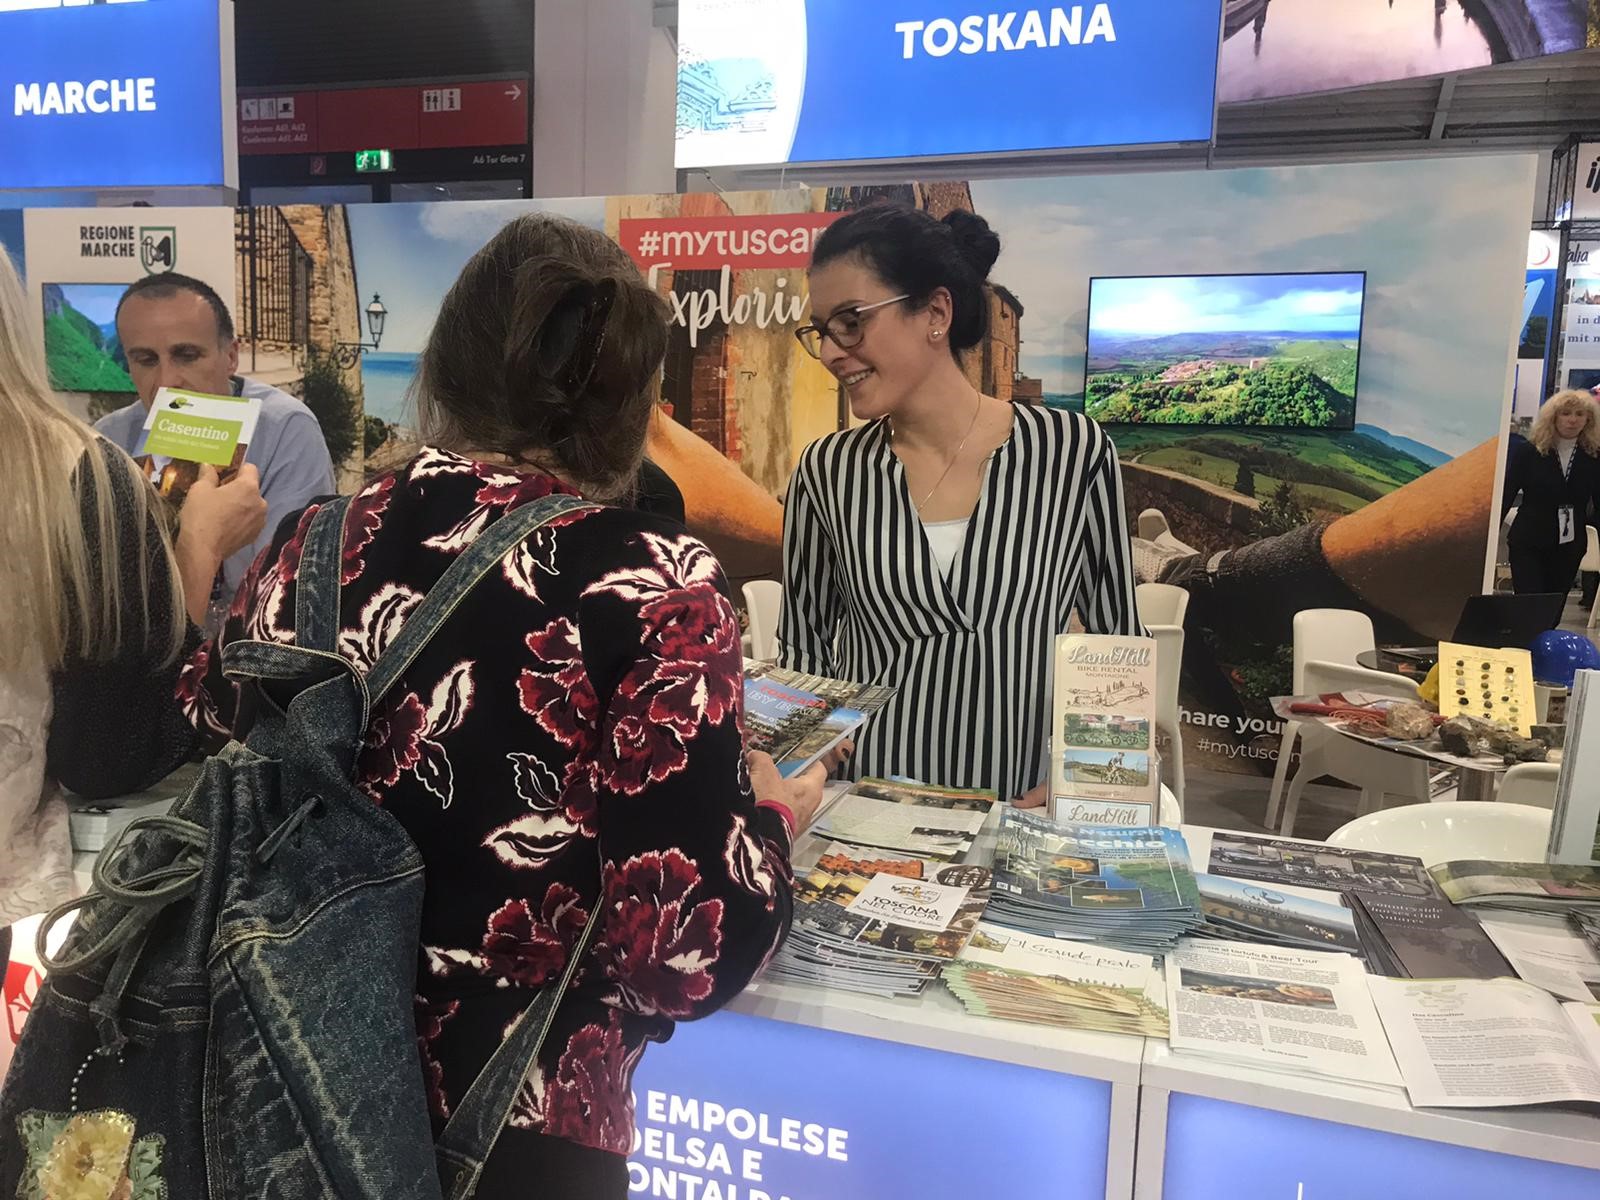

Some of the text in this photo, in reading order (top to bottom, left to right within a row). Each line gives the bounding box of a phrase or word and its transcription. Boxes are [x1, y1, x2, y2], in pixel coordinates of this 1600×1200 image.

[895, 3, 1117, 59] TOSKANA
[14, 77, 156, 116] MARCHE
[80, 226, 135, 241] REGIONE
[81, 242, 135, 257] MARCHE
[1567, 243, 1589, 264] alia
[158, 418, 229, 441] Casentino
[1178, 705, 1230, 729] hare
[1068, 804, 1138, 826] LandHill
[861, 898, 888, 911] NEL
[892, 907, 945, 921] CUORE
[872, 895, 939, 916] TOSCANA
[648, 1089, 849, 1162] EMPOLESE
[742, 1147, 763, 1182] E
